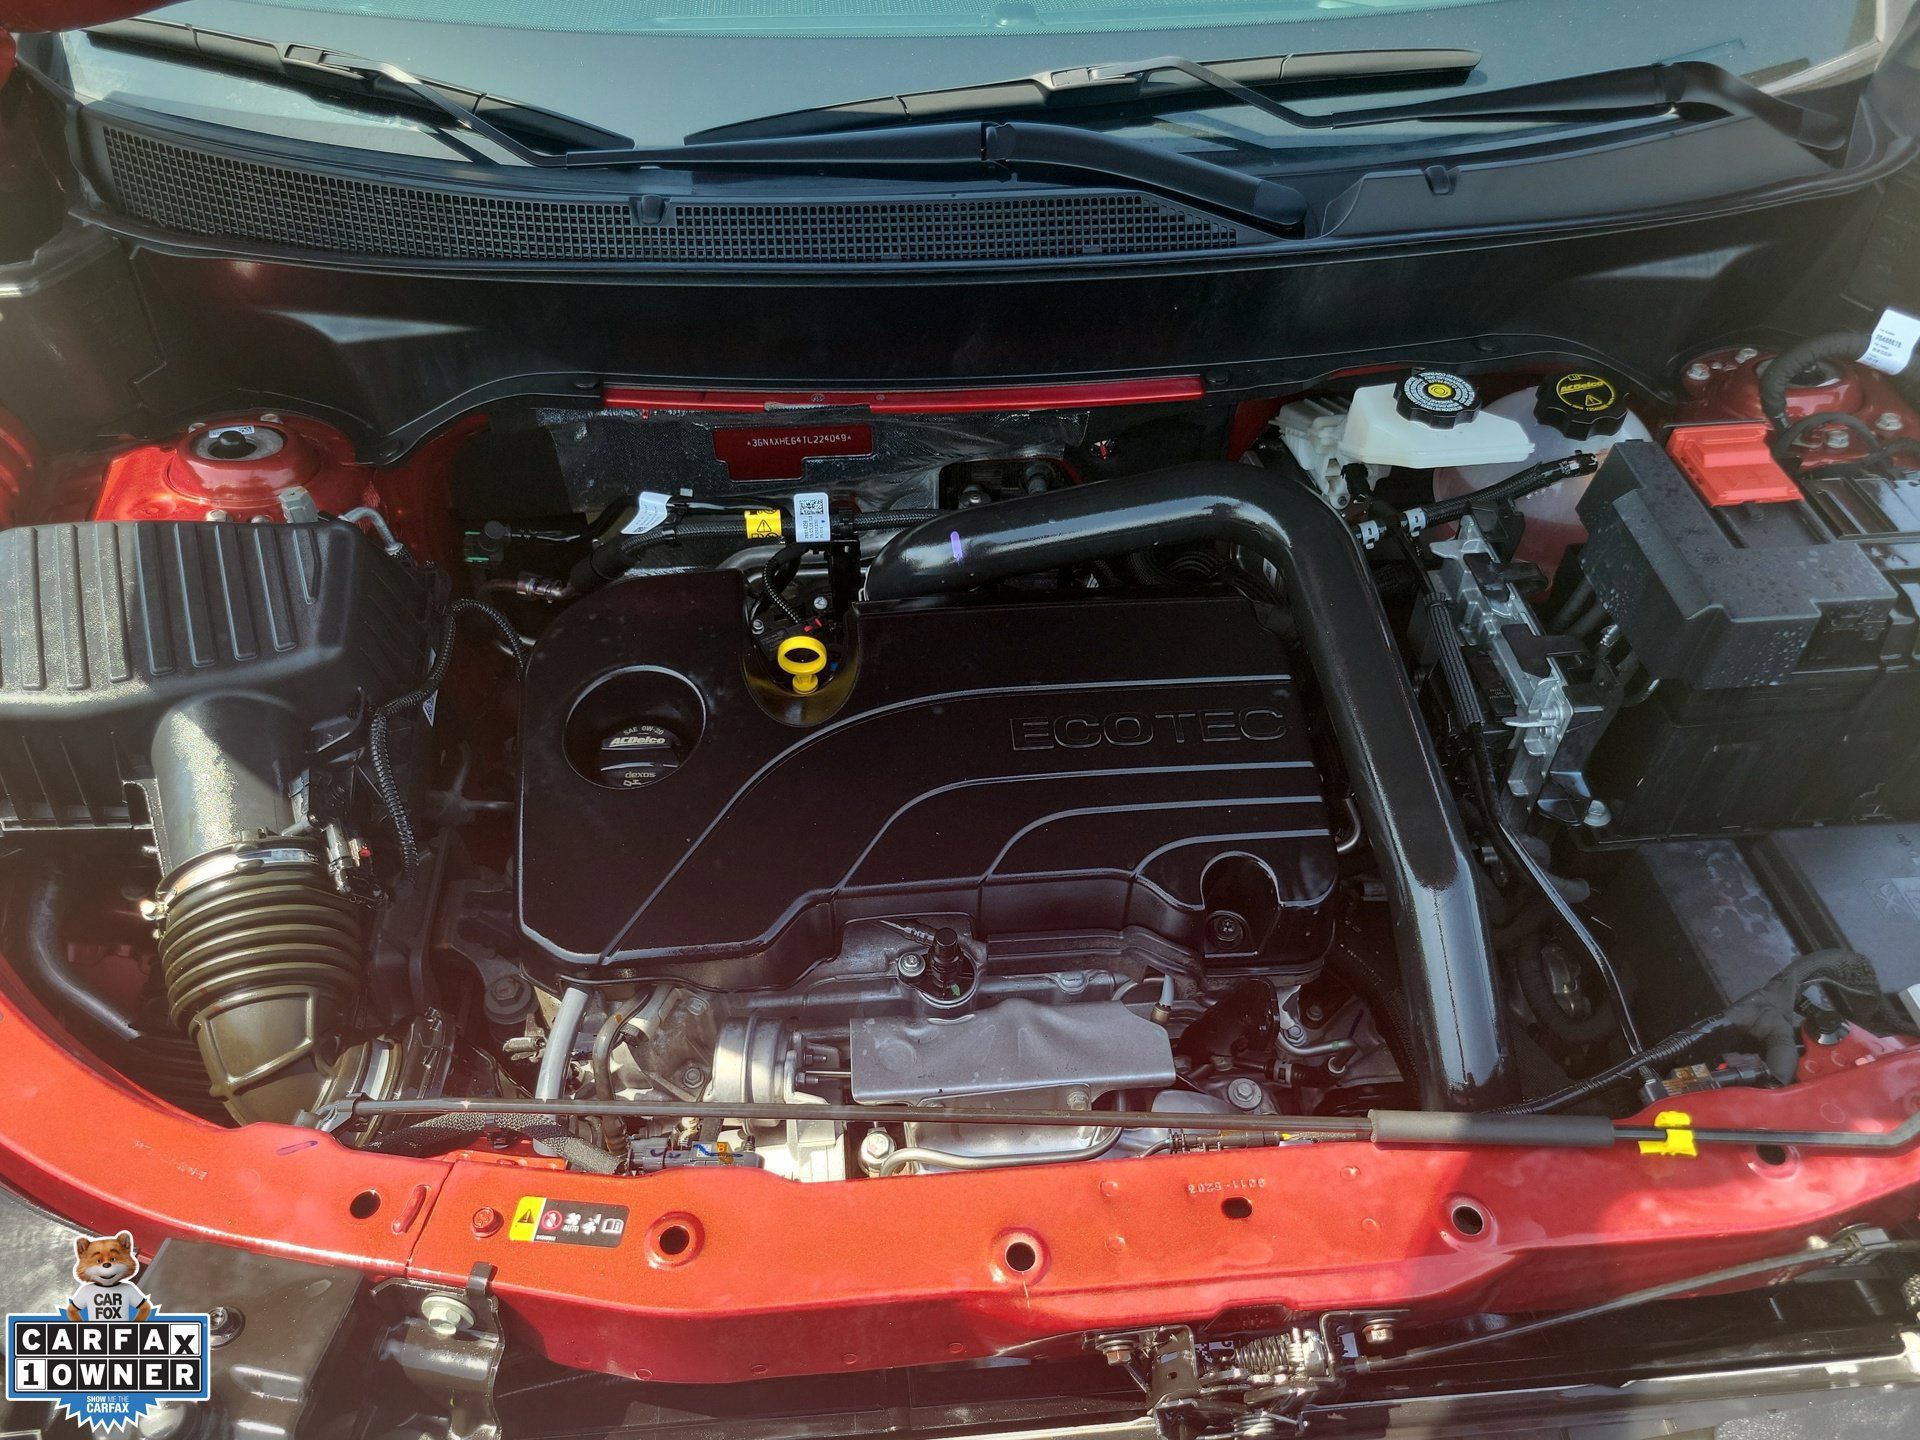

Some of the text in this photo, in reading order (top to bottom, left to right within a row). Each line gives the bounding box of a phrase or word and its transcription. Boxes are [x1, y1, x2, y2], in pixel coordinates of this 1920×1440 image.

[623, 726, 664, 735] SAE 0W-20
[1010, 707, 1286, 750] ECOTEC
[610, 736, 665, 746] ACDelco
[562, 1224, 579, 1232] AUTO
